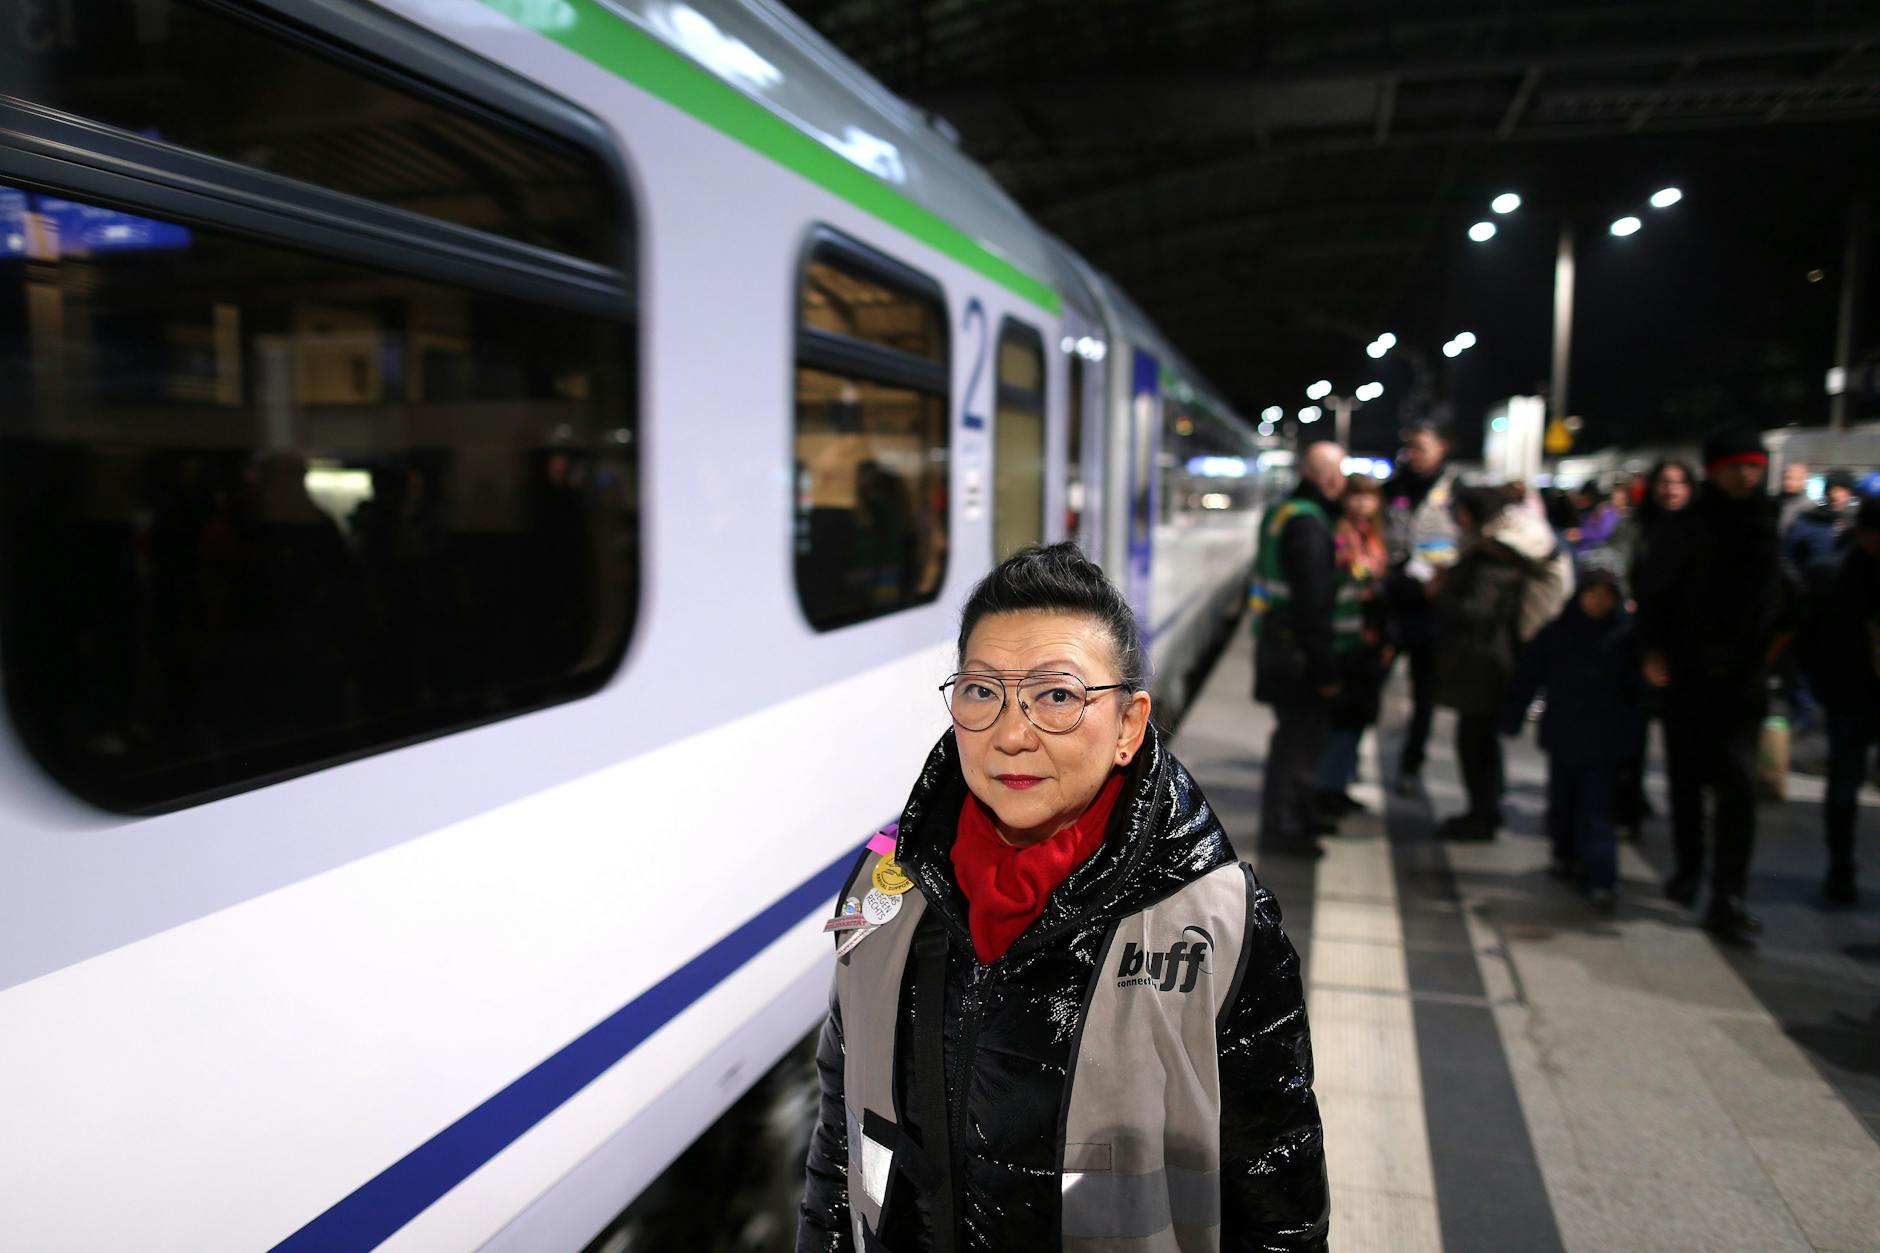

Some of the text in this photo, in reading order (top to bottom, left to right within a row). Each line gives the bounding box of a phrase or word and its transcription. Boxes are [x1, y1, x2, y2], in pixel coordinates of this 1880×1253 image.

[962, 296, 989, 430] 2
[888, 880, 911, 891] SUPPOR
[865, 894, 886, 920] RECHTS
[874, 890, 893, 914] GEGEN
[1117, 941, 1208, 993] buff
